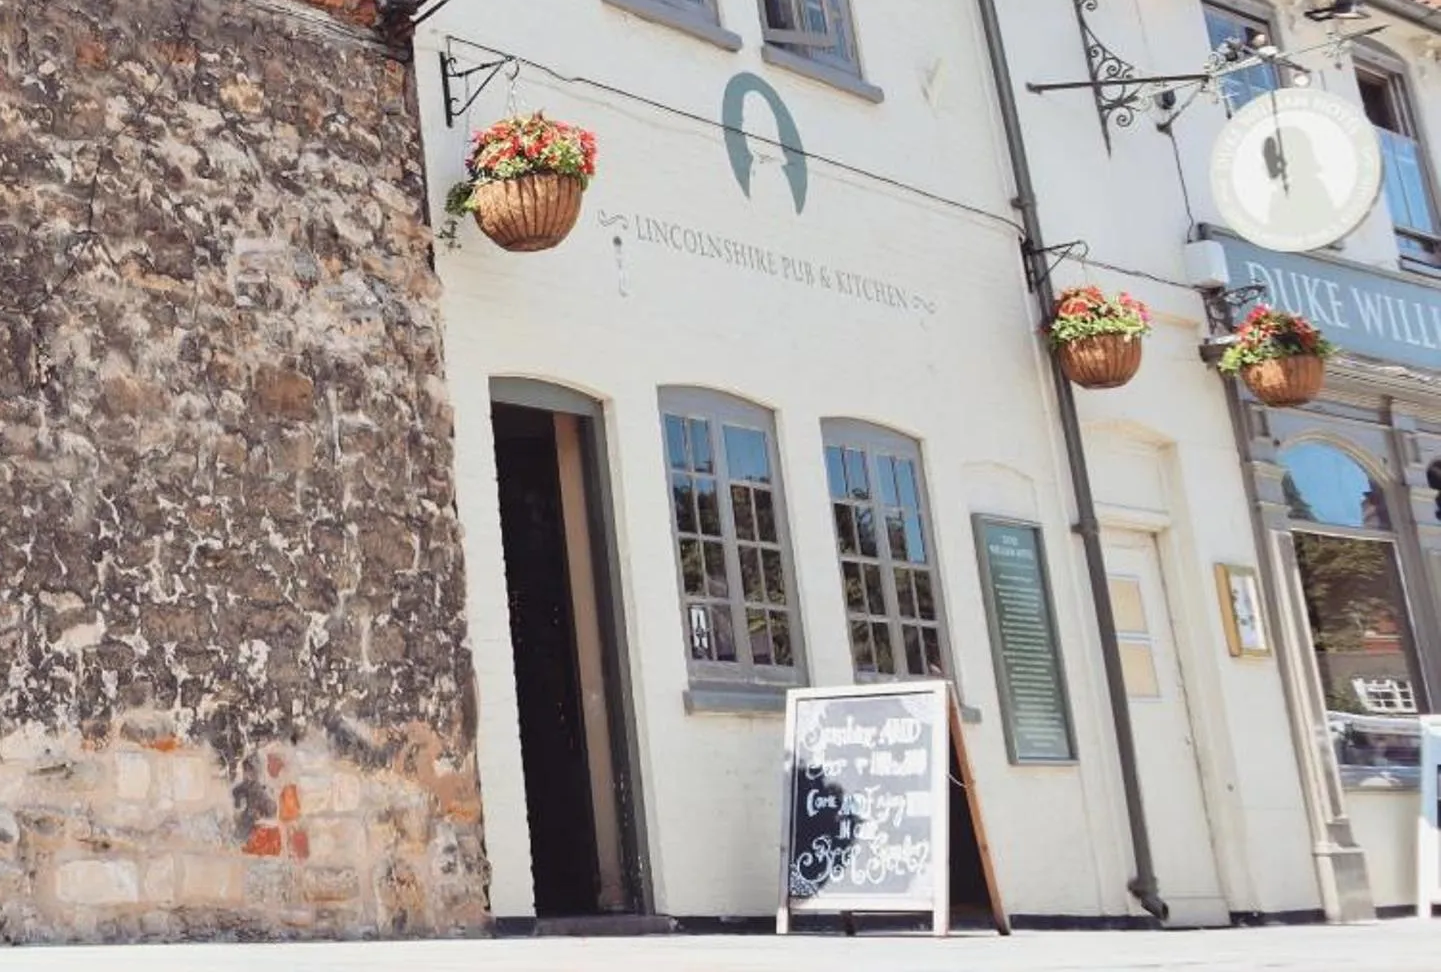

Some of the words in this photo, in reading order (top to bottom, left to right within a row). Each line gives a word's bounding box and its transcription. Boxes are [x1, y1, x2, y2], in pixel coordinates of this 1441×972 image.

[635, 214, 778, 275] LINCOLNSHIRE
[781, 256, 815, 285] PUB
[819, 265, 832, 289] &
[834, 269, 908, 309] KITCHEN
[1246, 260, 1350, 329] DUKE
